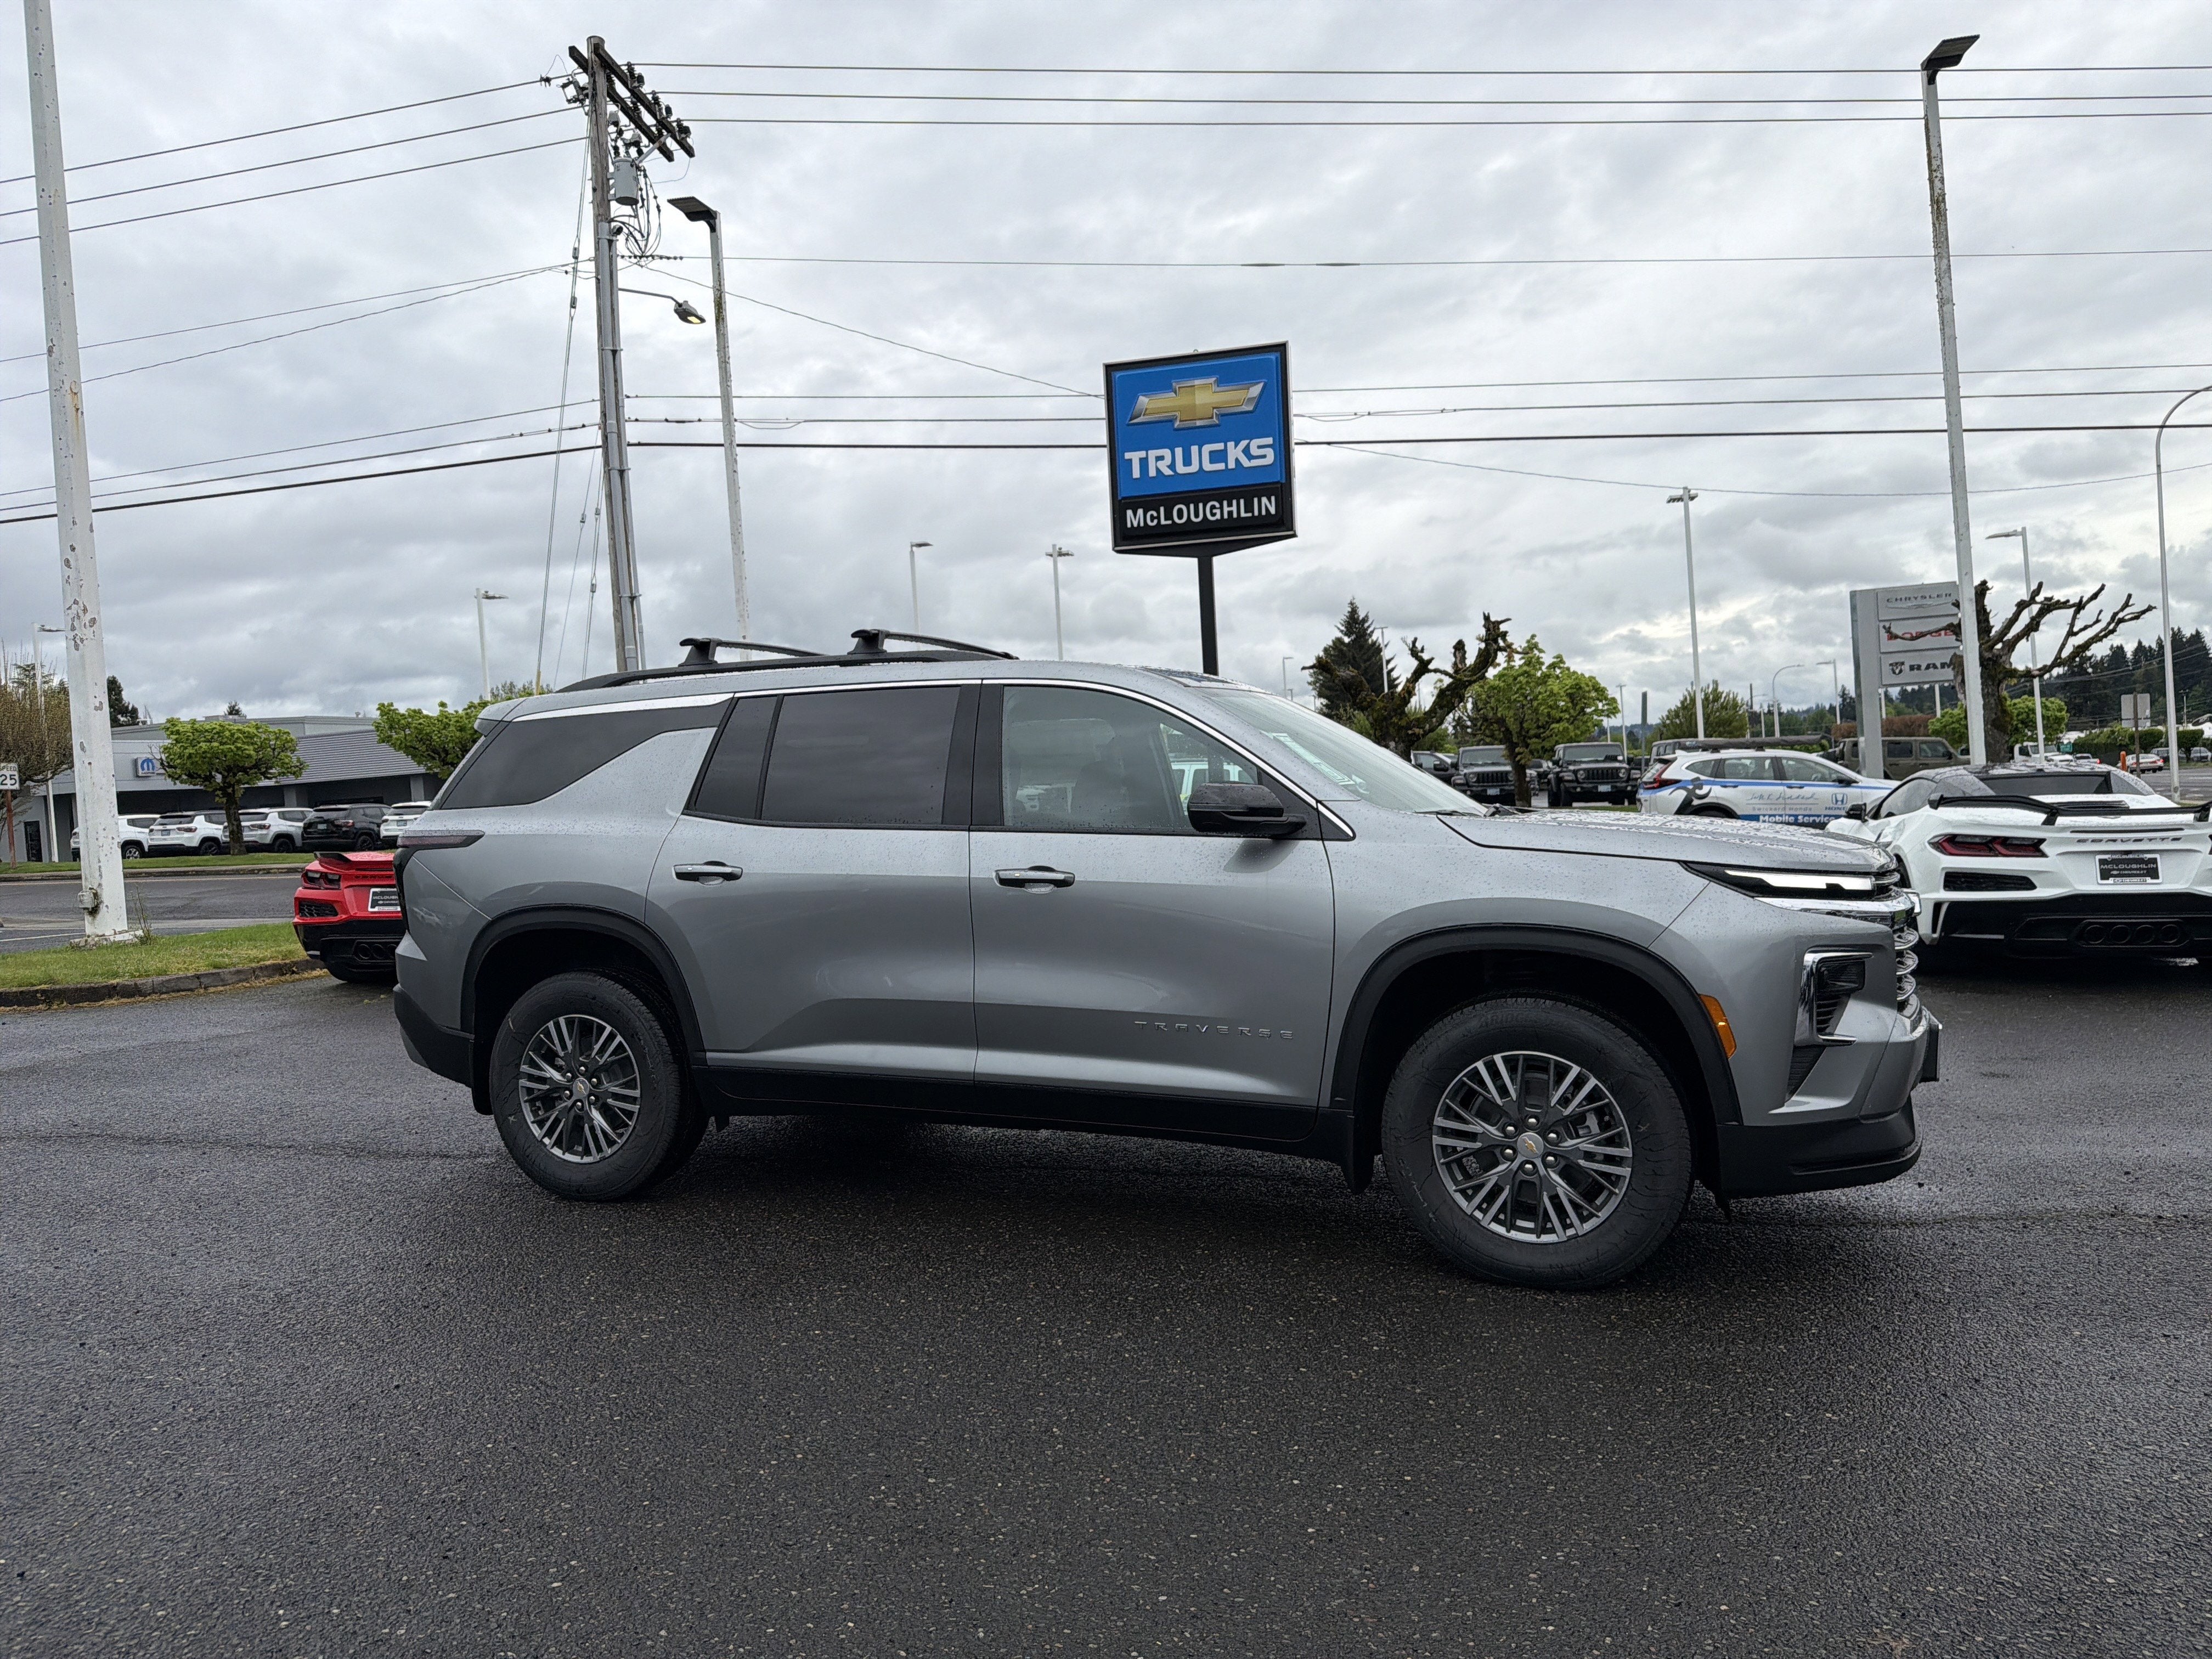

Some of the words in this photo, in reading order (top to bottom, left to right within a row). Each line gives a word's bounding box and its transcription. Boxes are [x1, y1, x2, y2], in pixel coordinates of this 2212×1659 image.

[1124, 437, 1274, 479] TRUCKS
[1126, 495, 1276, 528] McLOUGHLIN
[1886, 592, 1952, 603] CHRYSLER
[1909, 661, 1952, 672] RAM
[0, 774, 17, 786] 25
[1759, 814, 1795, 823] Mobile
[1133, 1020, 1294, 1040] TRAVERSE
